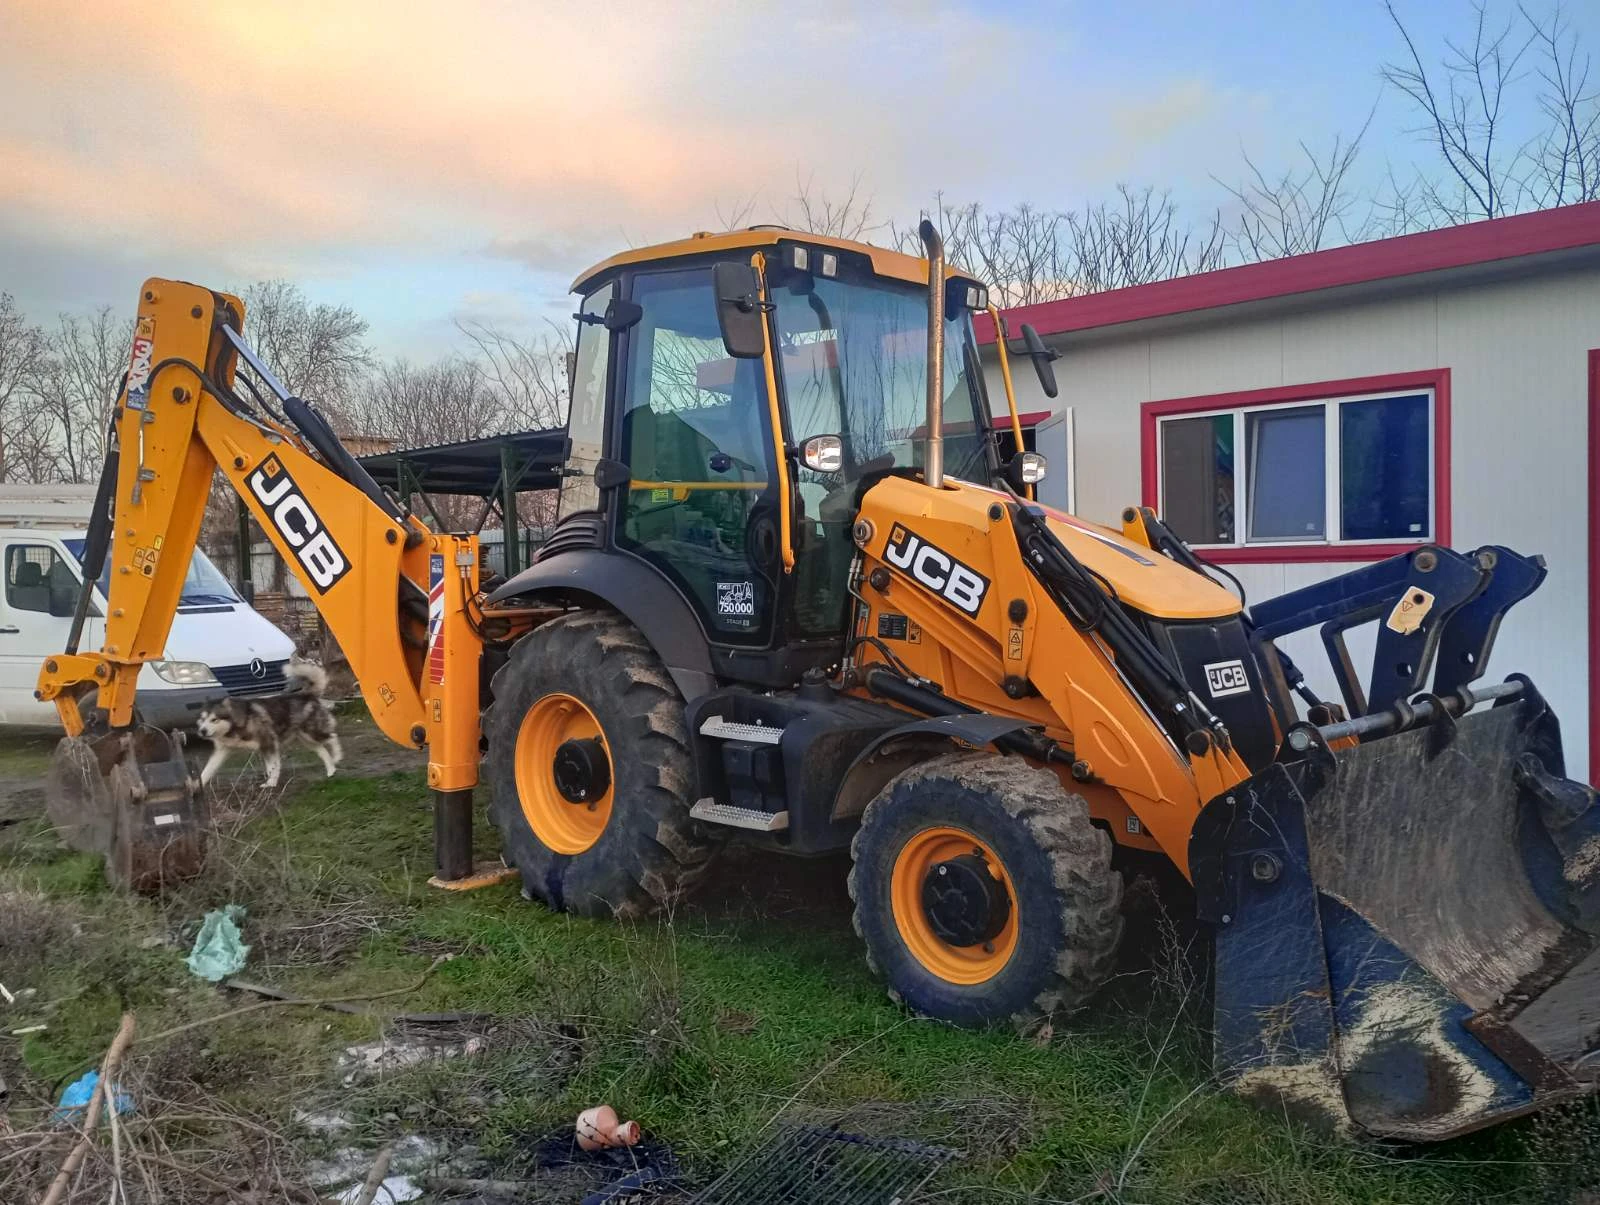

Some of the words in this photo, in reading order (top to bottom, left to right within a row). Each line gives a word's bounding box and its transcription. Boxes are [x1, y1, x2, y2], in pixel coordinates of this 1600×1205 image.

[250, 470, 345, 588] JCB
[886, 536, 985, 612] JCB
[1209, 666, 1246, 690] JCB
